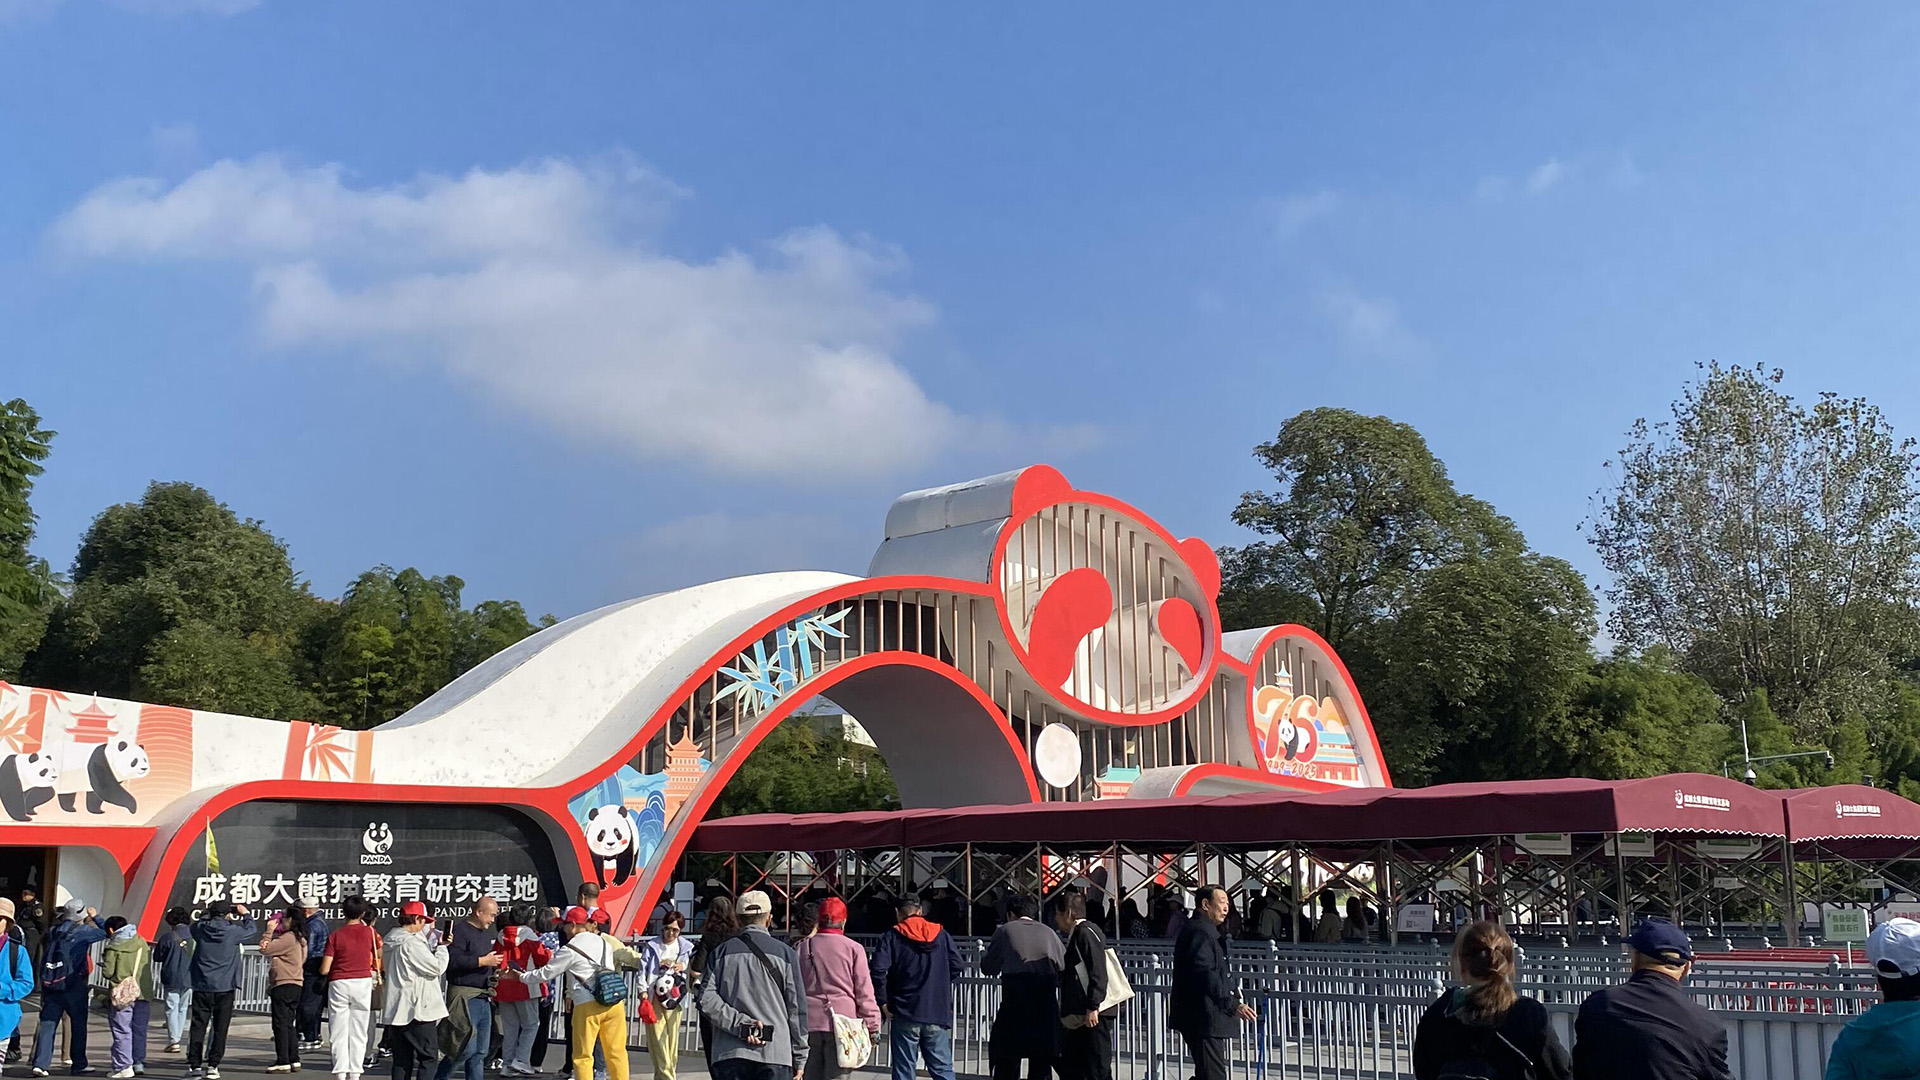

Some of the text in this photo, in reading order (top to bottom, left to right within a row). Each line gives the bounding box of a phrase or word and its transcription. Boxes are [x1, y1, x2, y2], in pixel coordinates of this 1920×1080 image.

[1267, 760, 1317, 777] 949-2025
[360, 854, 393, 865] PANDA
[192, 872, 538, 905] 成都大熊猫繁育研究基地
[434, 906, 473, 918] PANDA
